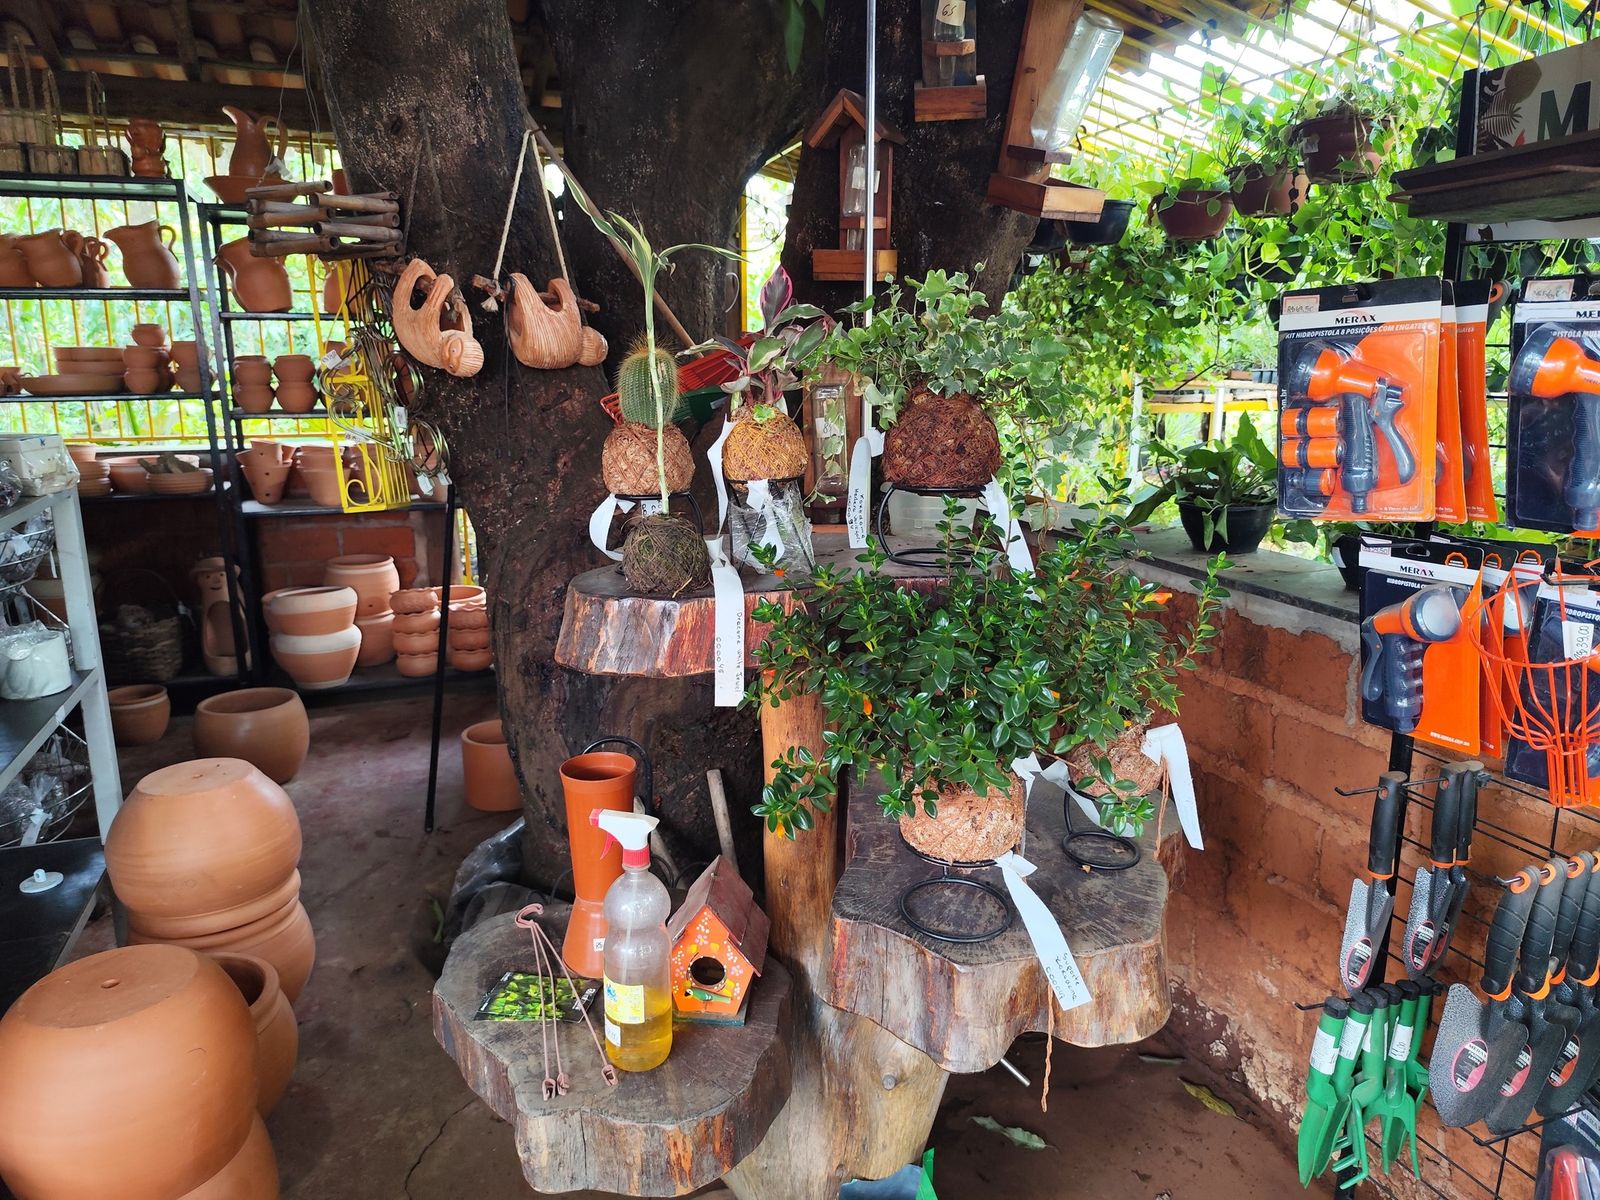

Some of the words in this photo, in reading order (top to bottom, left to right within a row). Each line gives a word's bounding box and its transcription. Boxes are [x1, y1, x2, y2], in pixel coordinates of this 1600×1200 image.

[1335, 314, 1377, 325] MERAX
[1296, 330, 1340, 339] HIDROPISTOLA
[1346, 326, 1378, 335] POSIÇÕES
[1378, 324, 1394, 332] COM
[1400, 565, 1435, 578] MERAX
